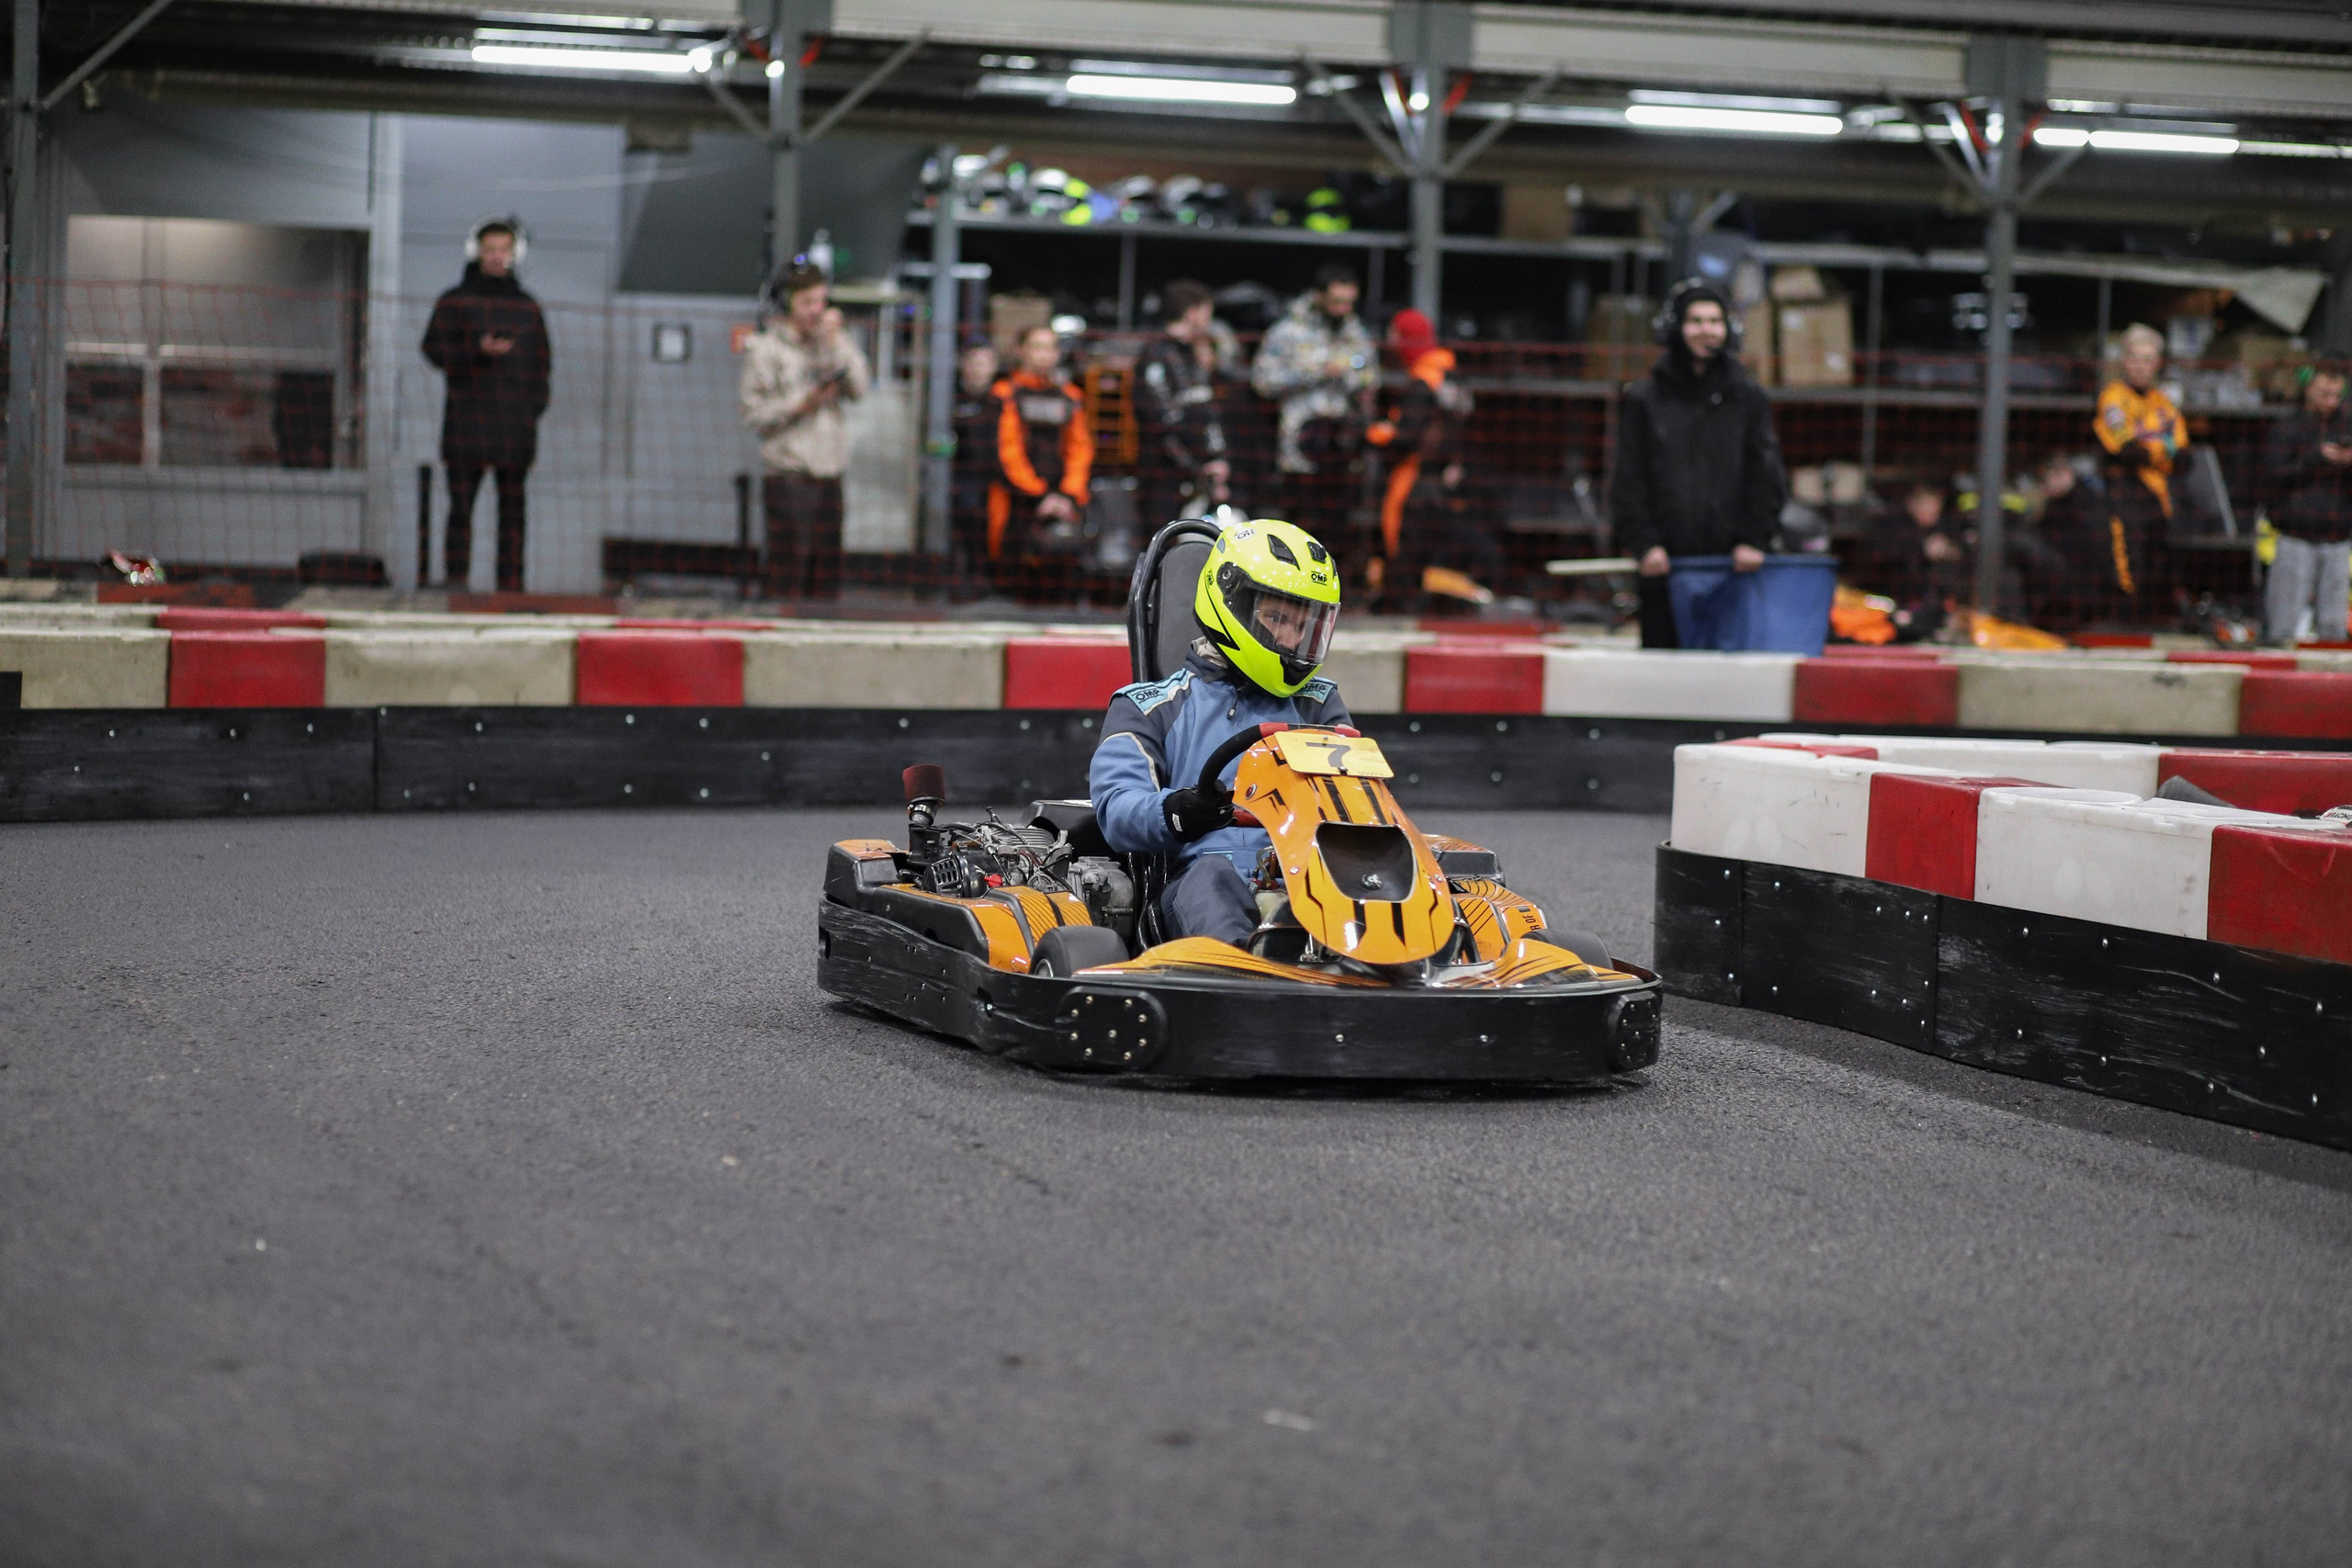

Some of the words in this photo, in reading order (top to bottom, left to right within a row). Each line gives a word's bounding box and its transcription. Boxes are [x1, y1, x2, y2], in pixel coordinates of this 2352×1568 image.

[1311, 573, 1327, 582] OMP
[1136, 690, 1159, 700] OMP
[1305, 741, 1351, 768] 7
